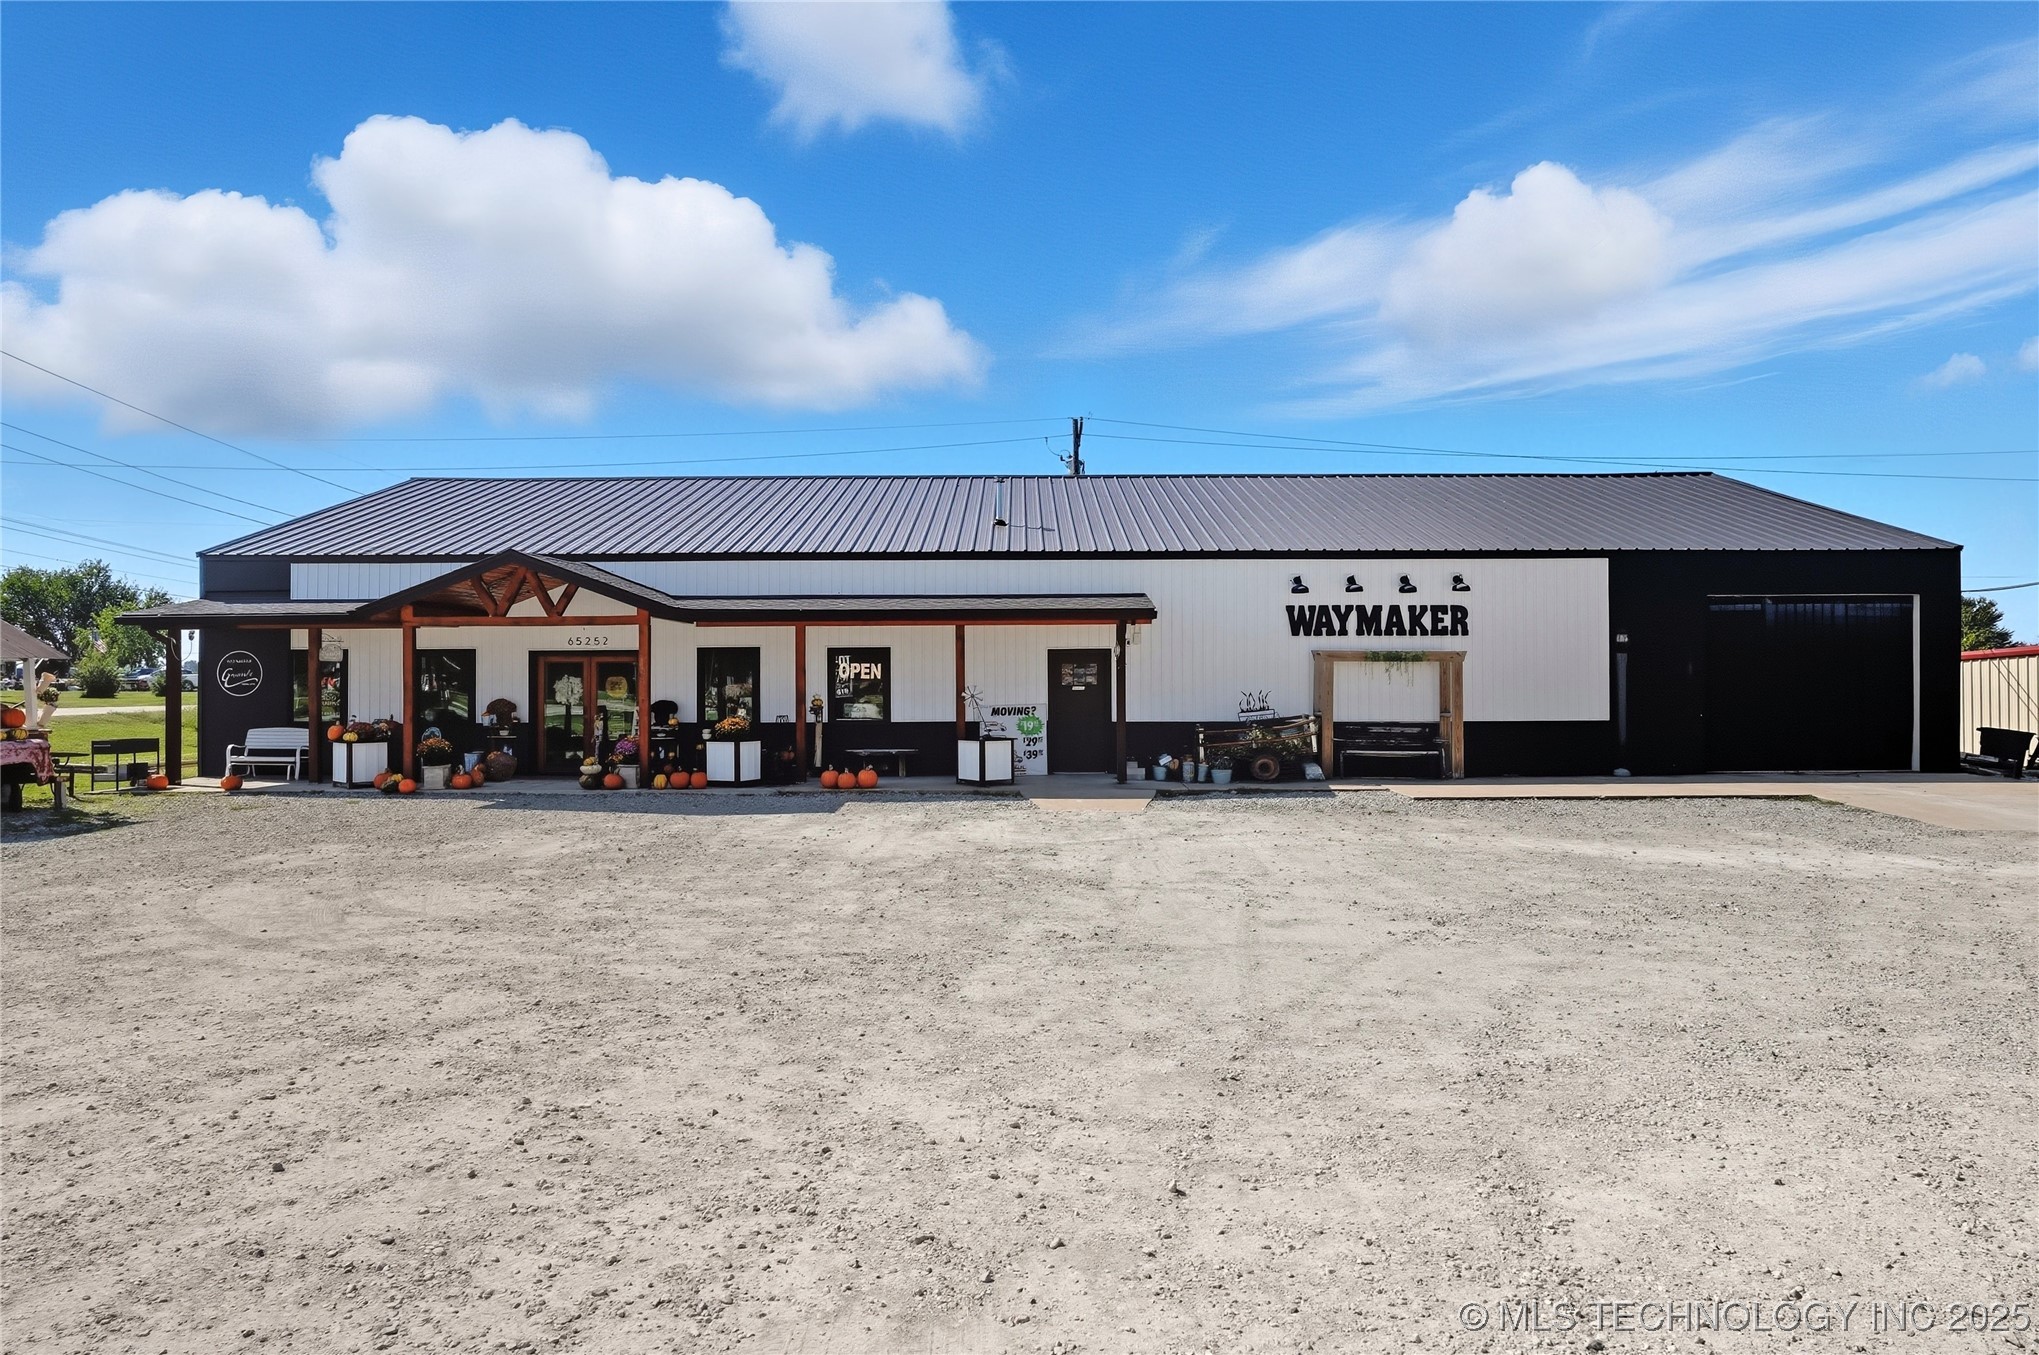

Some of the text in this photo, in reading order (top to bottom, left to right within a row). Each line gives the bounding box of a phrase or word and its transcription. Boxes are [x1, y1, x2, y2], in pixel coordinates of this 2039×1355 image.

[1285, 604, 1469, 636] WAYMAKER
[567, 636, 609, 646] 65252
[838, 662, 882, 680] OPEN
[990, 706, 1037, 717] MOVING?
